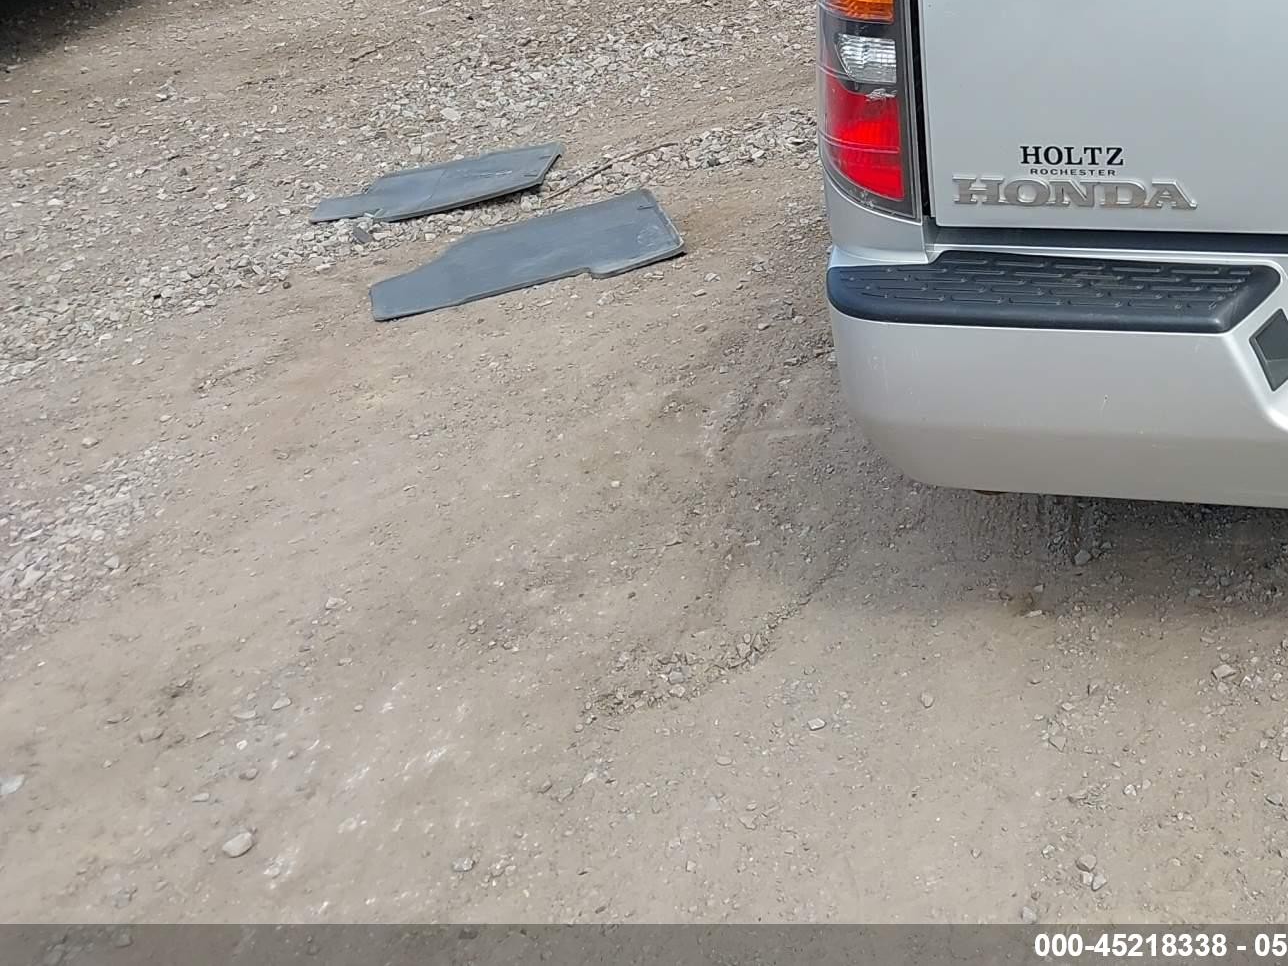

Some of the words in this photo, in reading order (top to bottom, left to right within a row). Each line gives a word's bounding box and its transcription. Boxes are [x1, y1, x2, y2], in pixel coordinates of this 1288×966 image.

[1020, 145, 1124, 166] HOLTZ
[1030, 168, 1116, 177] ROCHESTER
[952, 175, 1198, 210] HONDA
